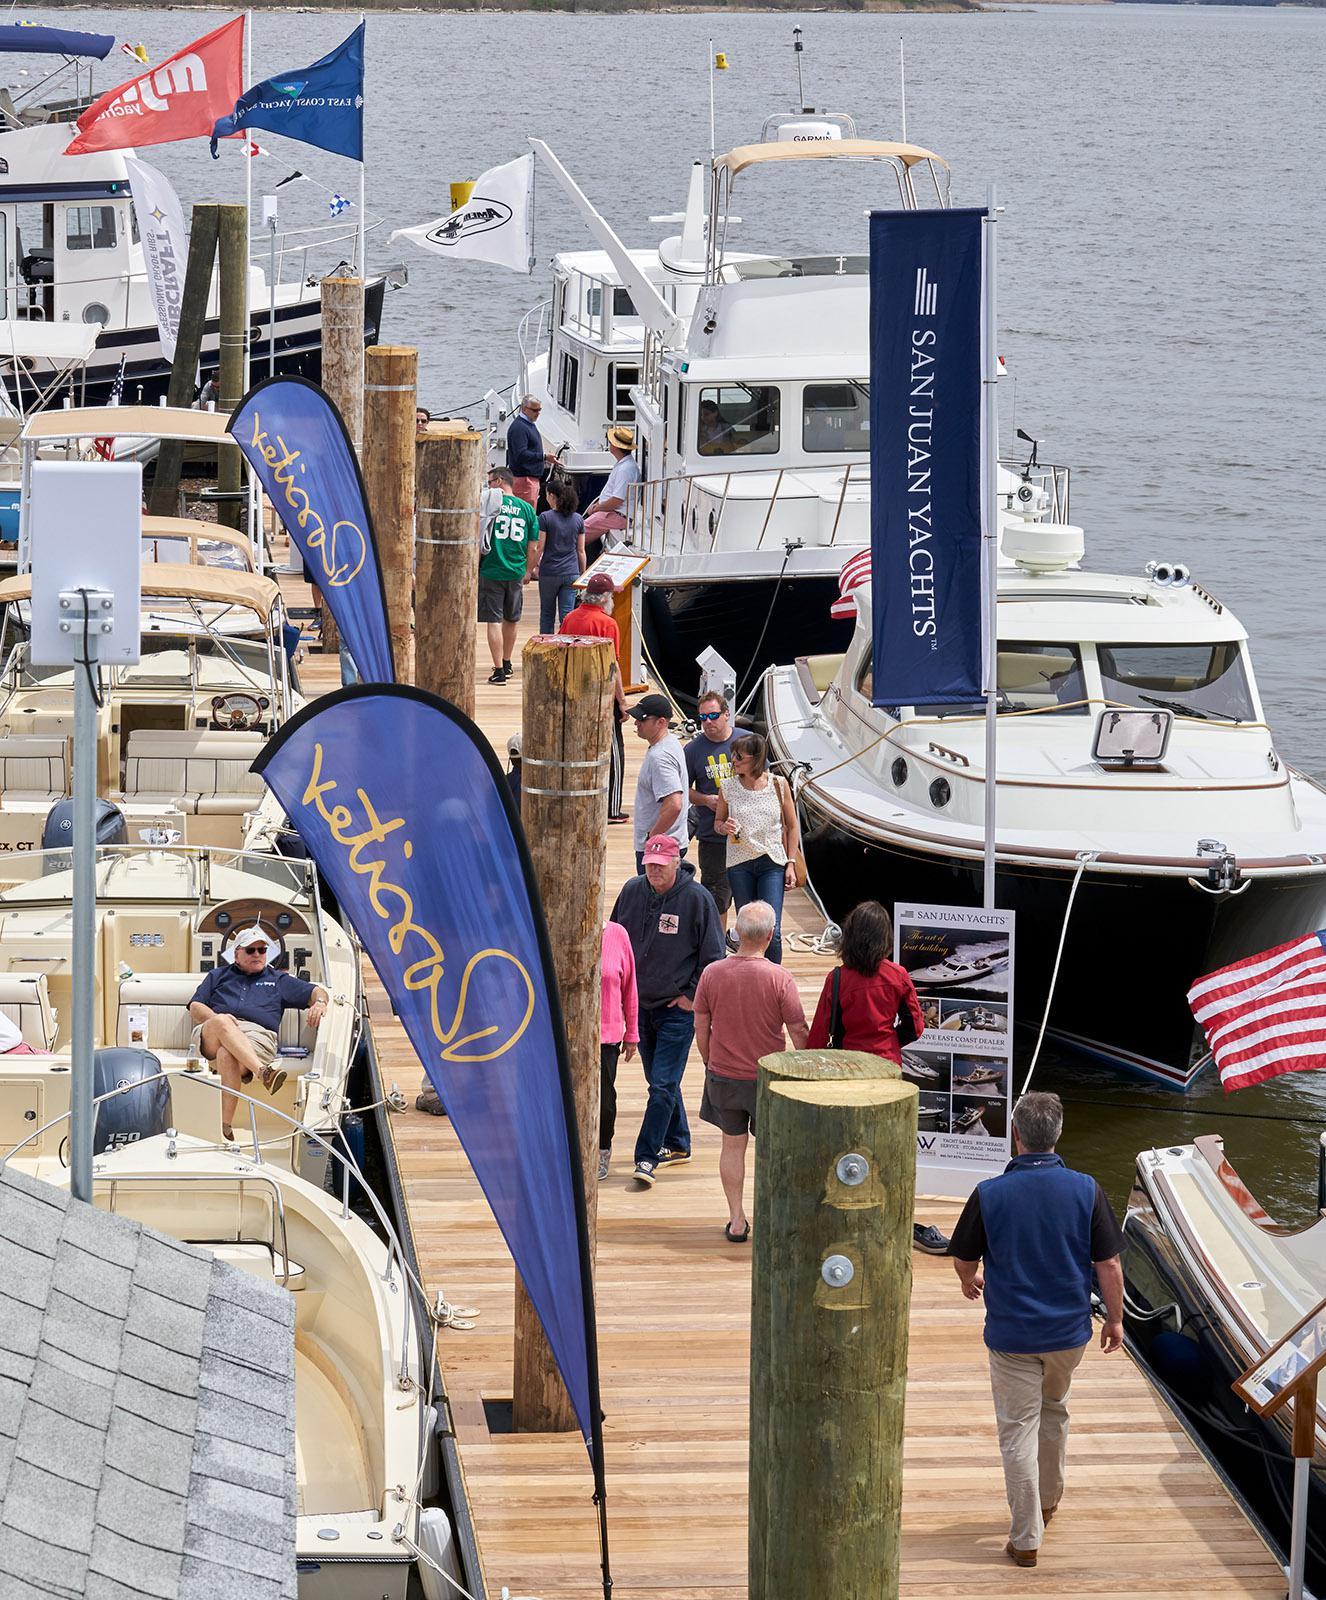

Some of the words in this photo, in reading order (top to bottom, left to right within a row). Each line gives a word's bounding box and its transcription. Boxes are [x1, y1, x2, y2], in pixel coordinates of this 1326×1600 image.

[910, 330, 937, 399] SAN
[907, 405, 933, 495] JUAN
[495, 515, 526, 541] 36
[17, 842, 34, 850] CT
[918, 911, 938, 920] SAN
[940, 912, 965, 922] JUAN
[967, 914, 1005, 925] YACHTS
[108, 1132, 141, 1142] 150
